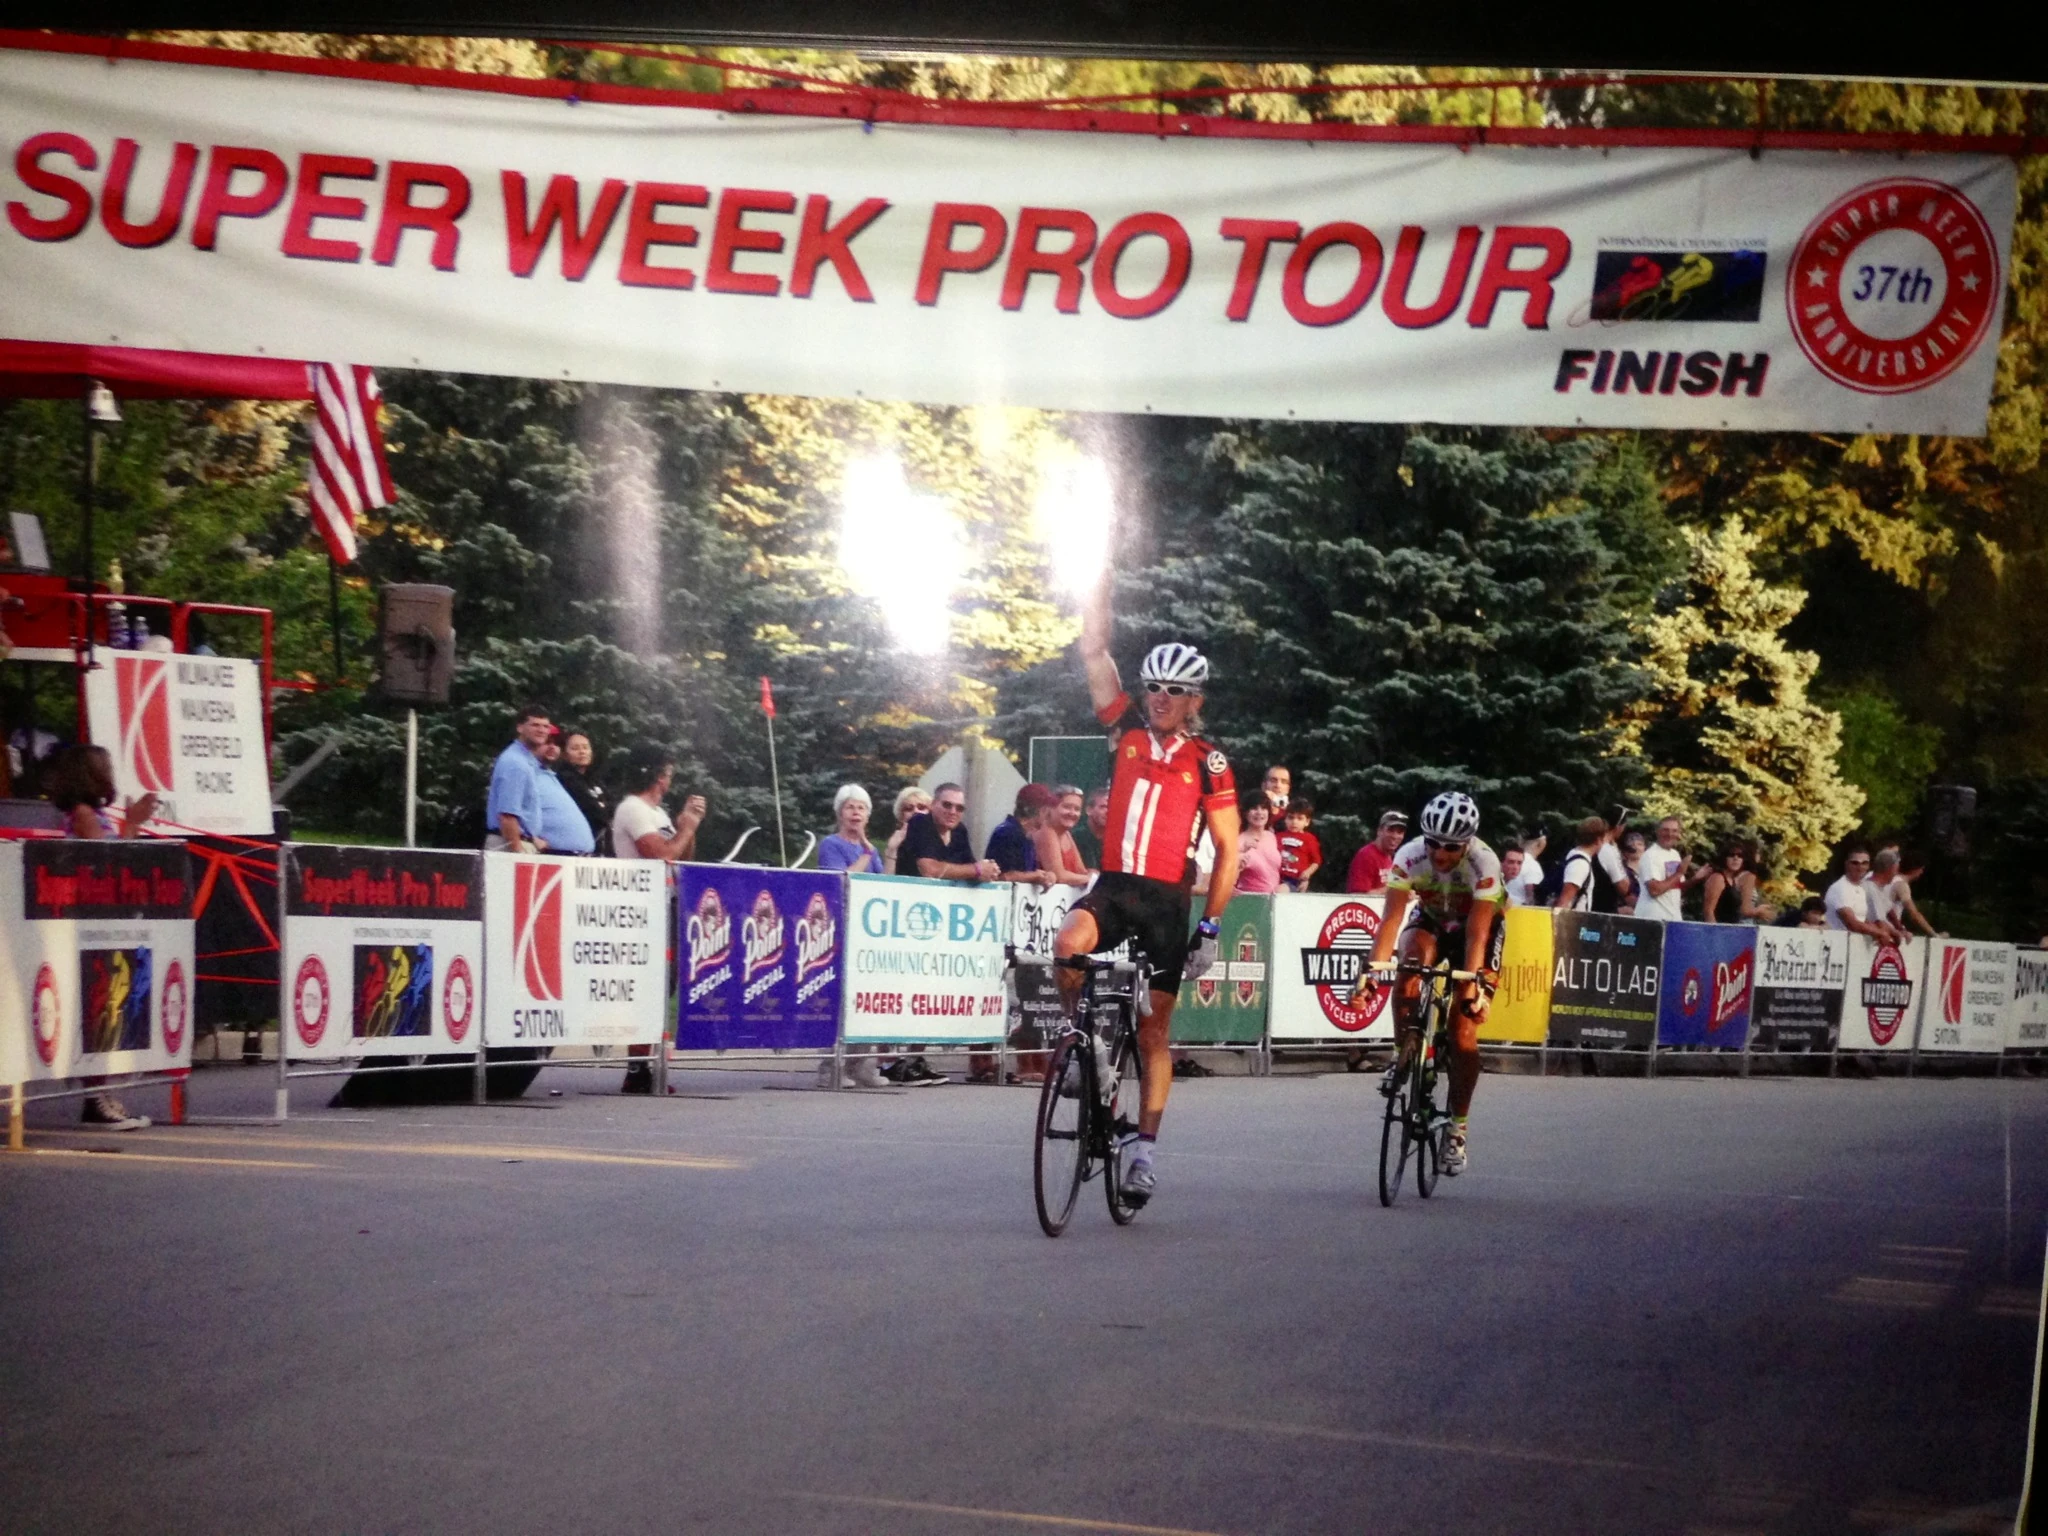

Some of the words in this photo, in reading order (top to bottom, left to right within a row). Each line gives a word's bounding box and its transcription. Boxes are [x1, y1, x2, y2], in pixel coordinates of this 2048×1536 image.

[7, 131, 472, 272] SUPER
[500, 169, 892, 303] WEEK
[914, 201, 1192, 319] PRO
[1219, 217, 1571, 330] TOUR
[1817, 195, 1900, 258] SUPER
[1917, 198, 1978, 261] WEEK
[1852, 265, 1934, 305] 37th
[1804, 303, 1973, 377] ANNIVERSARY
[1554, 349, 1771, 397] FINISH
[575, 866, 652, 893] MILWAUKEE
[575, 904, 648, 928] WAUKESHA
[573, 941, 649, 965] GREENFIELD
[687, 914, 731, 982] Point
[742, 916, 784, 983] Point
[795, 918, 835, 983] Point
[590, 979, 635, 1002] RACINE
[689, 964, 732, 1004] SPECIAL
[743, 965, 785, 1004] SPECIAL
[796, 966, 836, 1004] SPECIAL
[1516, 958, 1549, 1003] Light
[1716, 962, 1747, 1022] Point
[1863, 982, 1910, 1005] WATERFORD
[513, 1009, 564, 1038] SATURN
[855, 992, 902, 1014] PAGERS
[911, 994, 975, 1016] CELLULAR
[981, 995, 1002, 1016] DATA
[1324, 992, 1357, 1024] CYCLES
[1364, 994, 1383, 1018] USA
